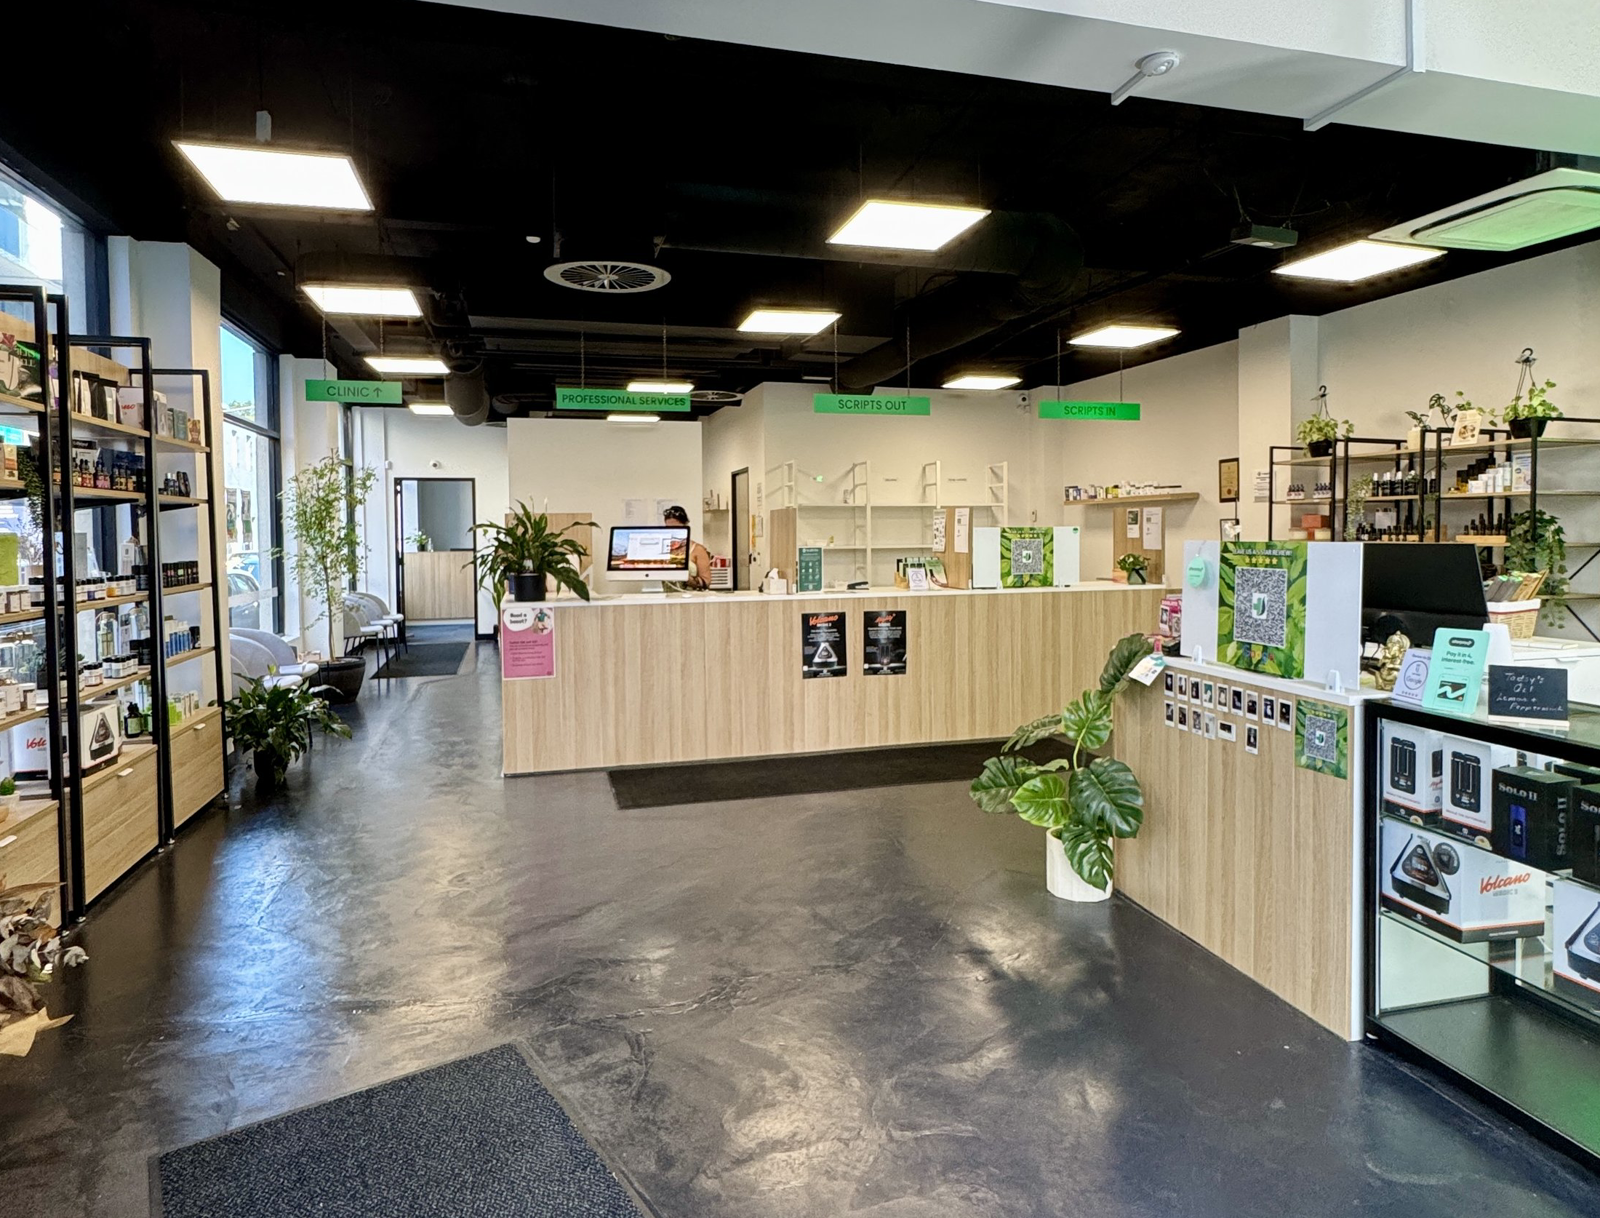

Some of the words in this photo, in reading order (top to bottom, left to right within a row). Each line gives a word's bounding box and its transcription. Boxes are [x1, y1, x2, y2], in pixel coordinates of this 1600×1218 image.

[326, 385, 370, 397] CLINIC
[562, 393, 637, 405] PROFESSIONAL
[639, 396, 687, 406] SERVICES
[838, 399, 882, 410] SCRIPTS
[885, 400, 907, 411] OUT
[1063, 405, 1104, 416] SCRIPTS
[1106, 406, 1116, 417] IN
[1479, 872, 1532, 894] Volcano
